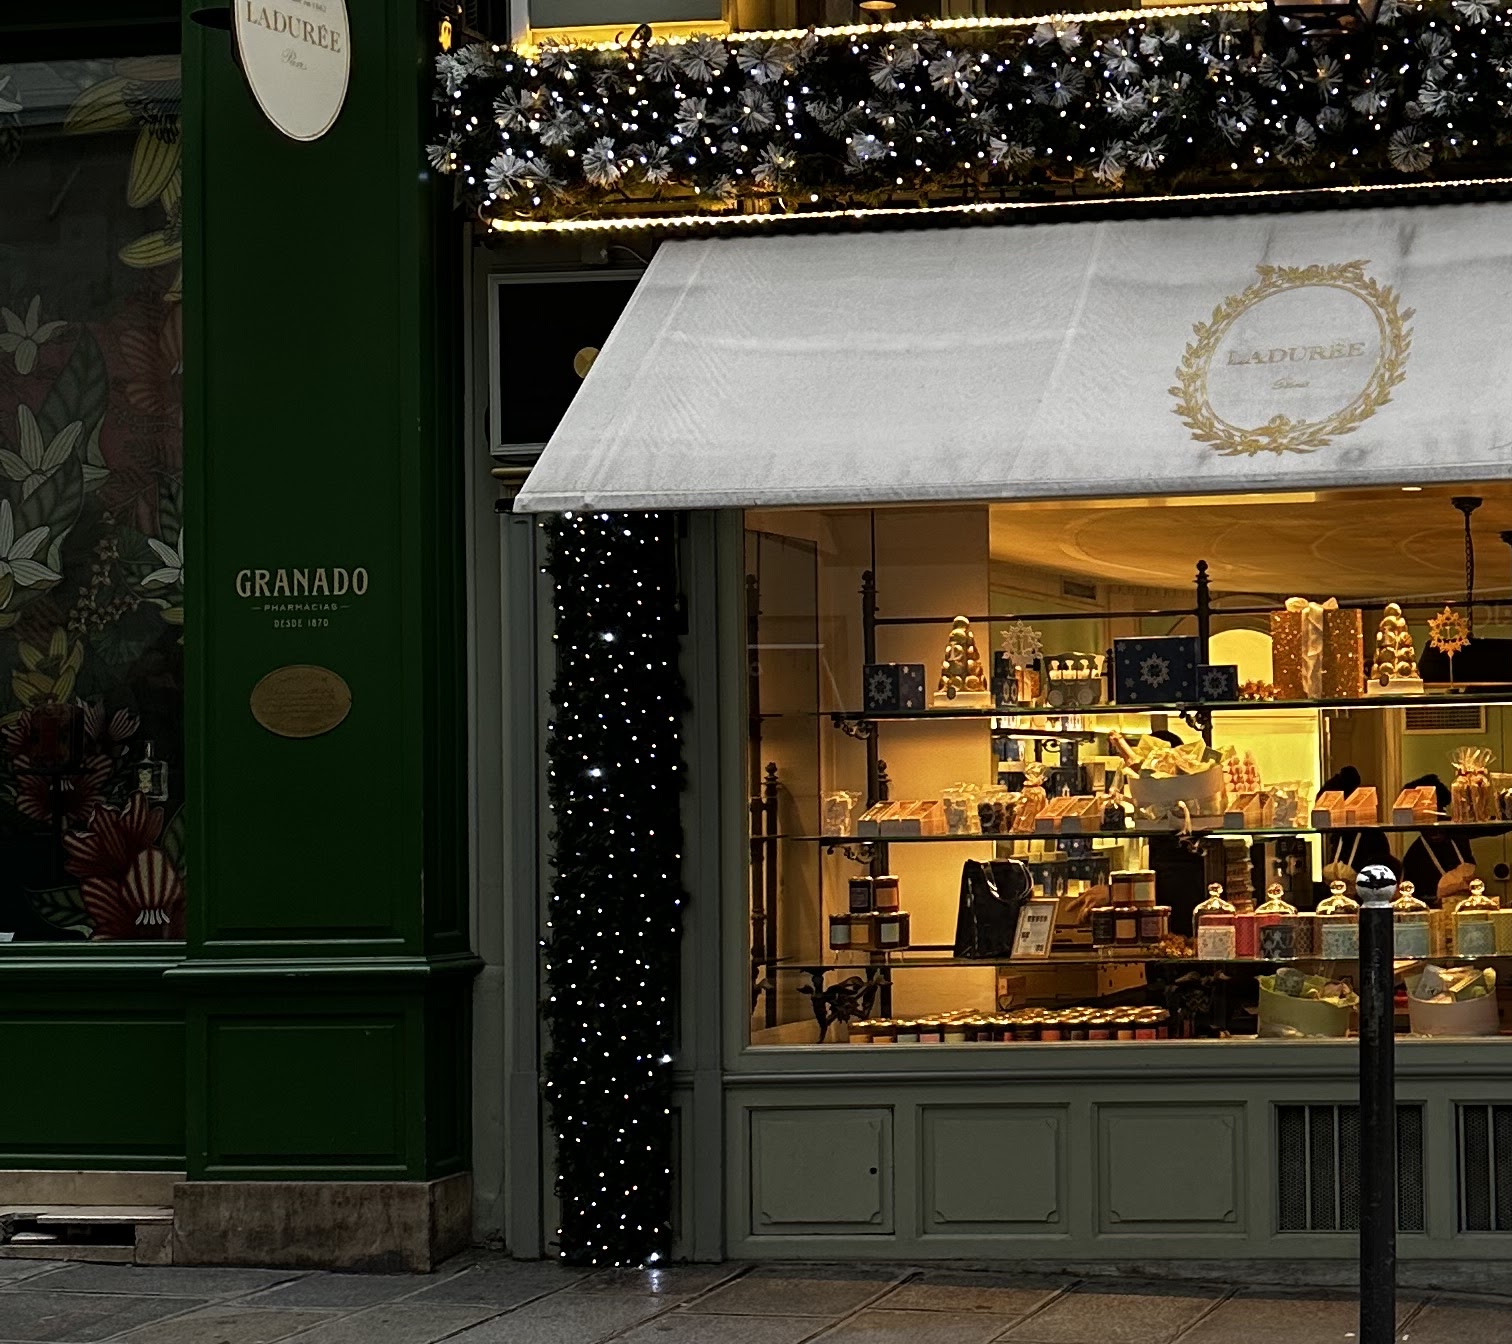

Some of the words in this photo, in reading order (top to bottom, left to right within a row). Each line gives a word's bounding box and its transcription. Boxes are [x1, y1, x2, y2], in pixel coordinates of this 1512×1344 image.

[1227, 341, 1366, 366] LADURÉE
[236, 567, 369, 598] GRANADO
[264, 603, 339, 612] PHARMACIAS
[273, 619, 303, 628] DESDE
[307, 618, 329, 627] 1870
